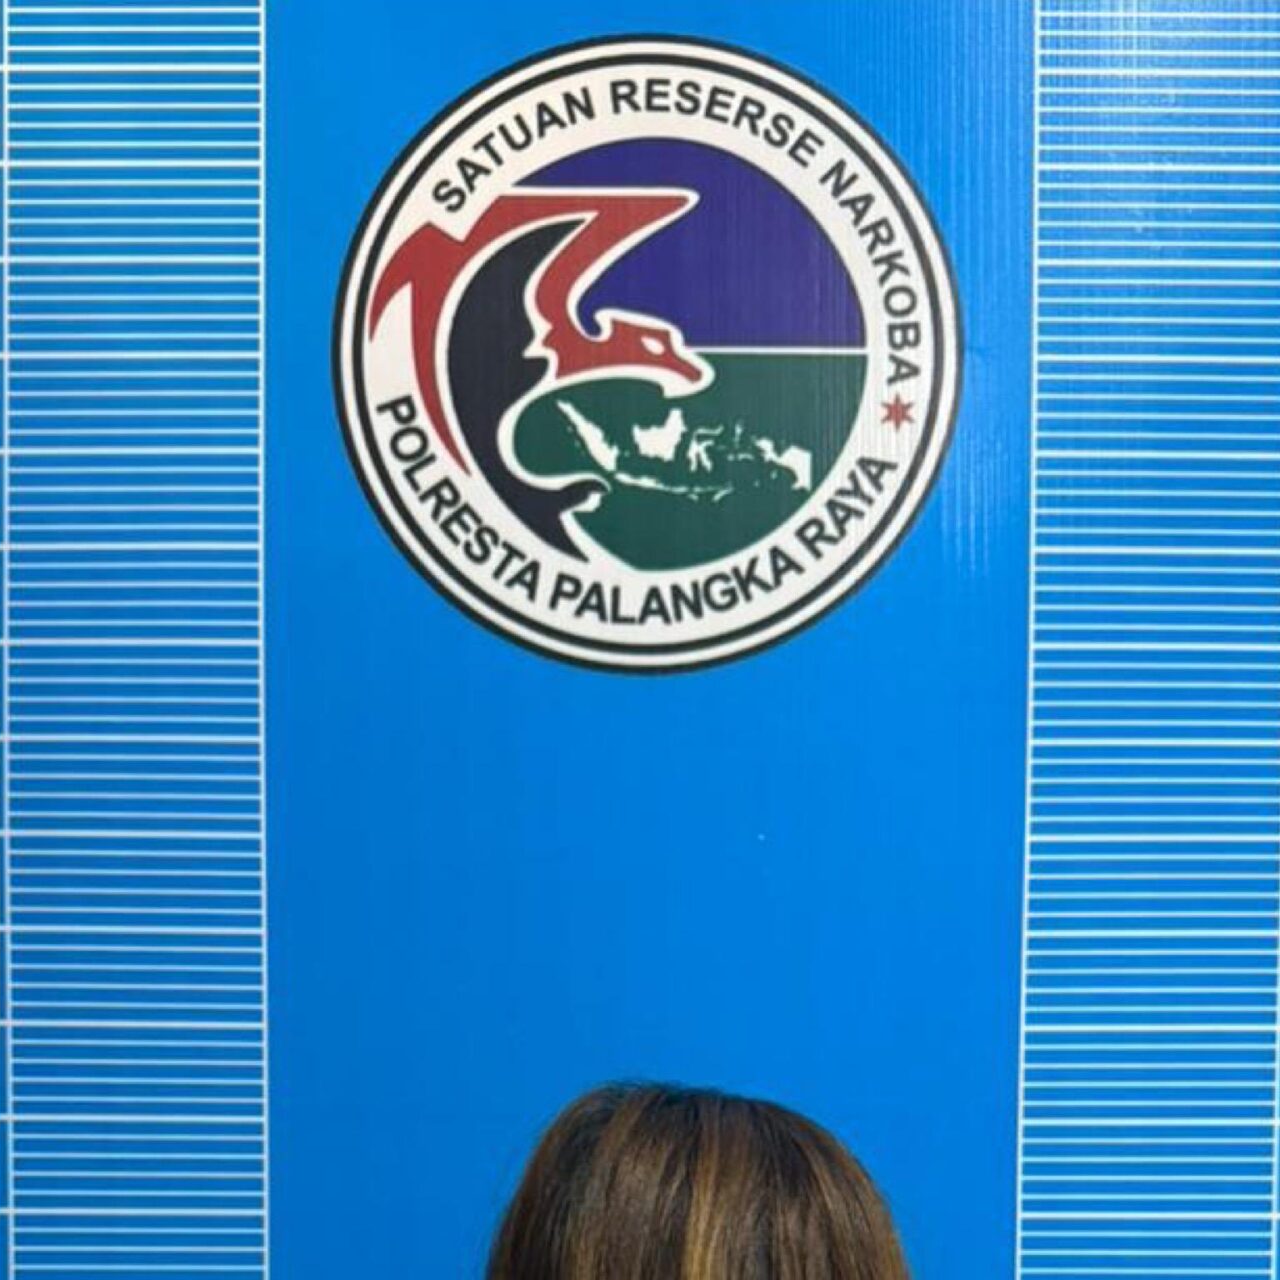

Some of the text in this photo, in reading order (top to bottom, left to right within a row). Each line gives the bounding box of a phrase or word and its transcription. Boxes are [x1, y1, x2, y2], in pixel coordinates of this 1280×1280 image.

[431, 77, 921, 385] SATUAN RESERSE NARKOBA
[375, 394, 898, 626] POLRESTA PALANGKA RAYA
